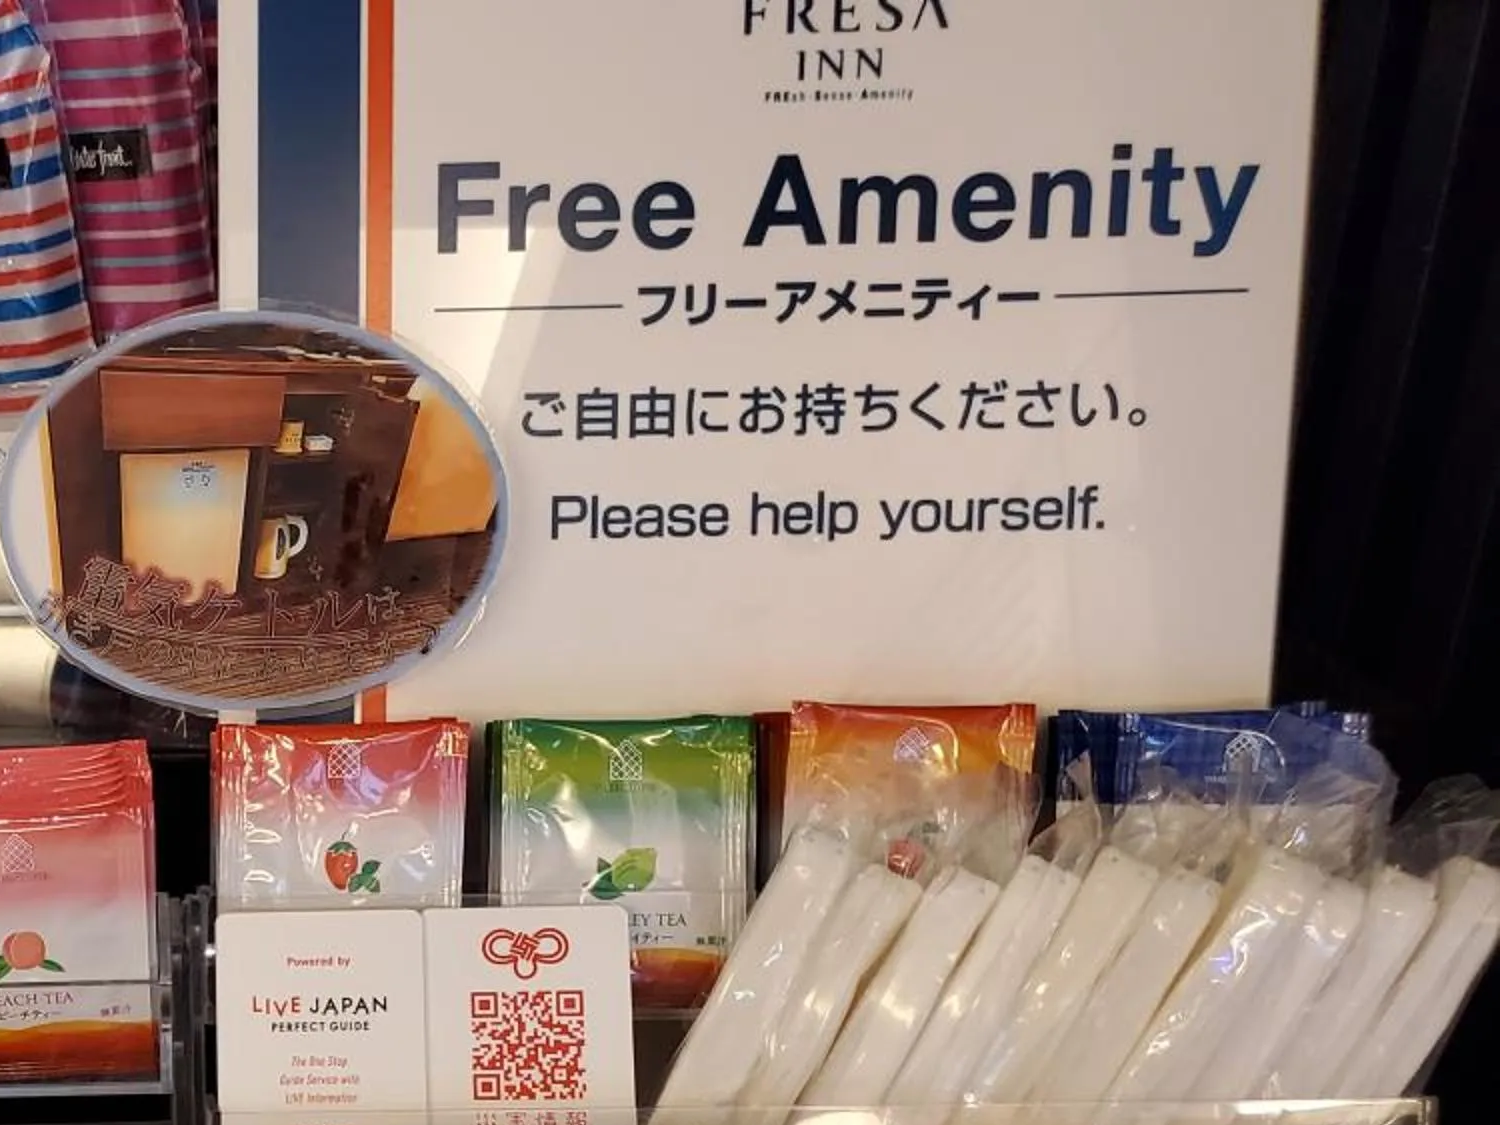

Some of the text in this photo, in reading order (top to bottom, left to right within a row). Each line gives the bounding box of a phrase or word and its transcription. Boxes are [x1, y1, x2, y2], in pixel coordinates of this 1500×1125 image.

[796, 47, 884, 81] INN
[436, 144, 1262, 258] Free Amenity
[637, 279, 1041, 327] フリーアメニティー
[519, 380, 1151, 442] ご自由にお持ちください。
[550, 486, 1107, 543] Please help yourself.
[655, 912, 688, 927] TEA
[286, 956, 351, 968] Powered by
[43, 991, 75, 1006] TEA
[309, 996, 388, 1015] JAPAN
[271, 1021, 371, 1033] PERFECT GUIDE
